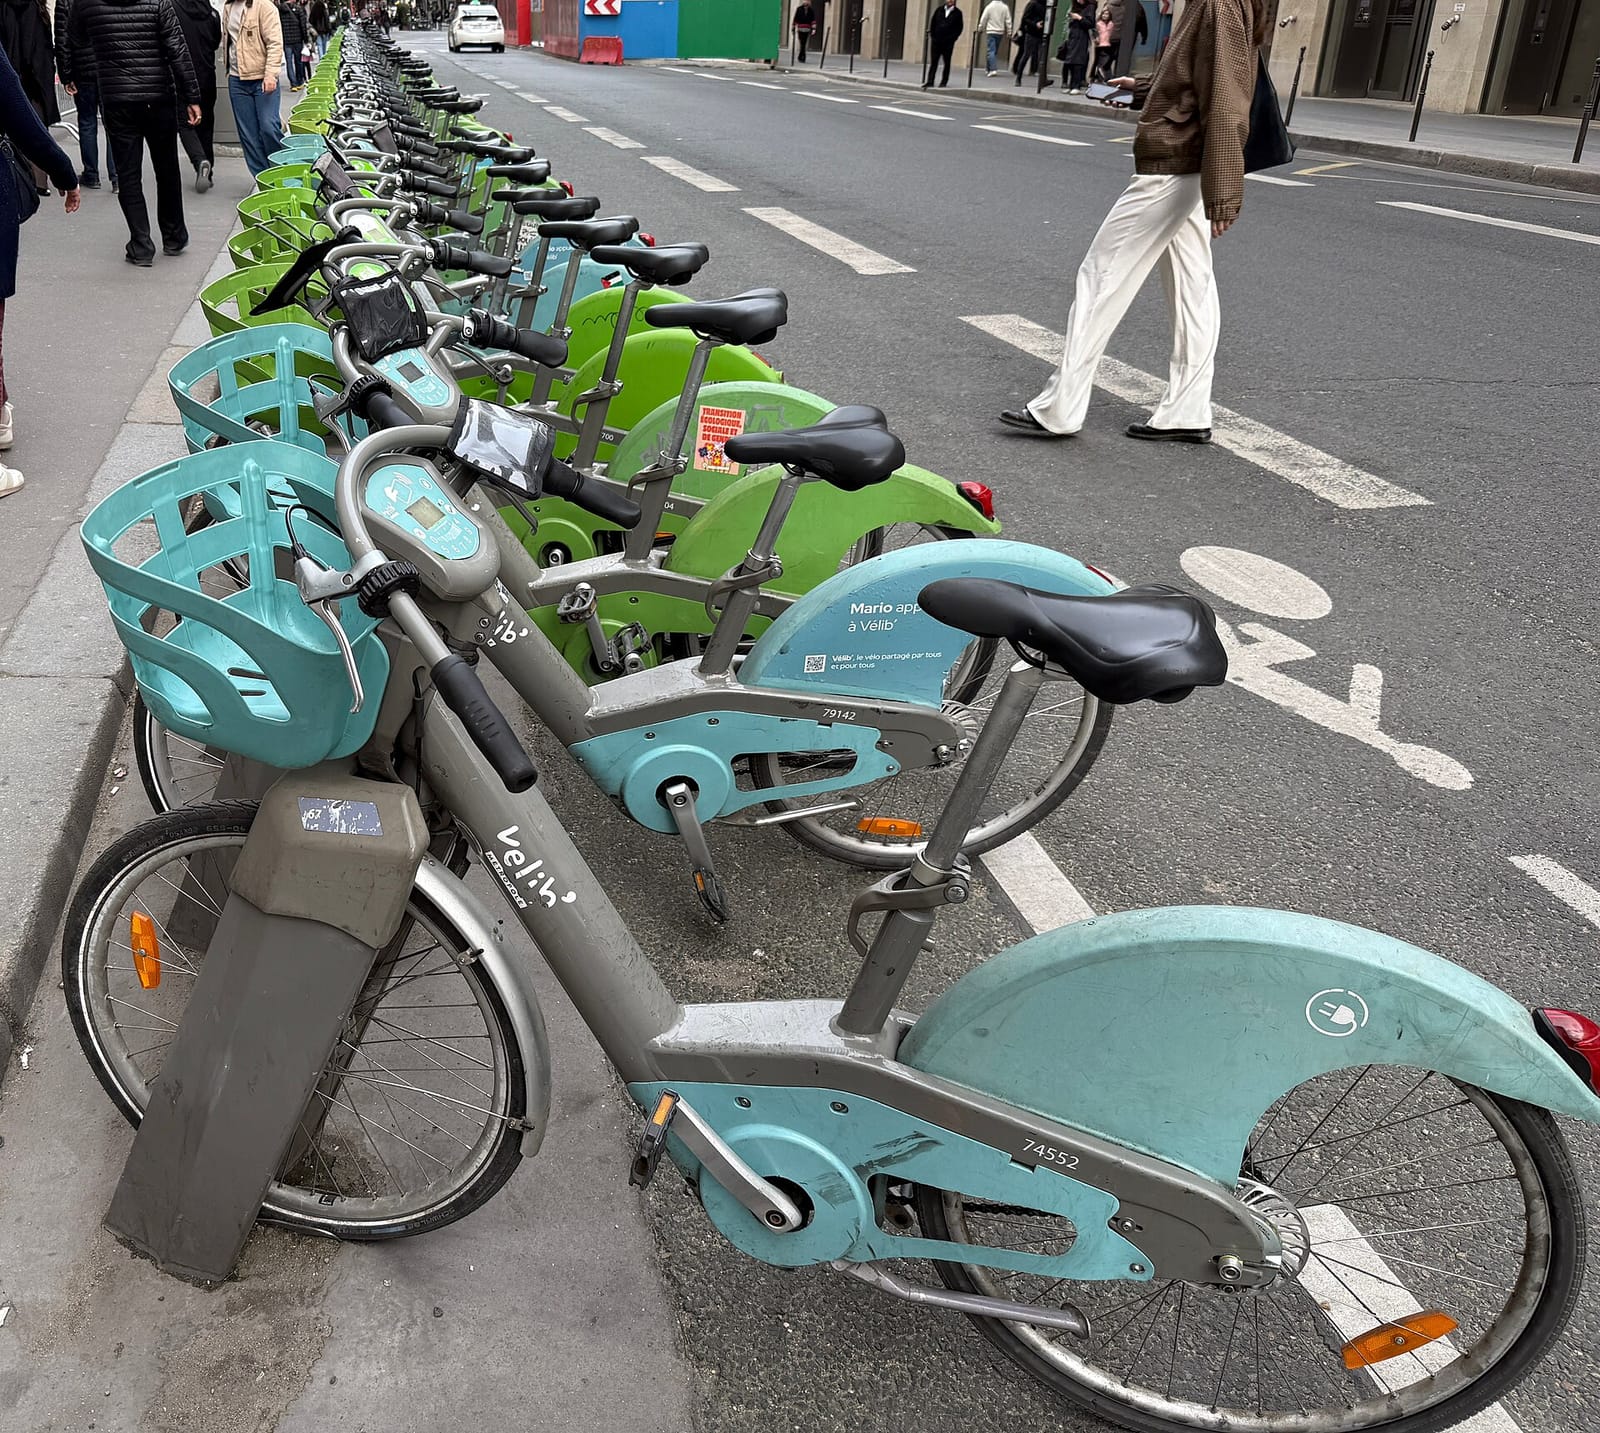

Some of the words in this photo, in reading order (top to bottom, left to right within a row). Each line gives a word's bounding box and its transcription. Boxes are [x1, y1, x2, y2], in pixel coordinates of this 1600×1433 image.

[702, 407, 742, 419] TRANSITION
[700, 415, 742, 428] ÉCOLOGIQUE,
[703, 425, 729, 435] SOCIALE
[730, 428, 738, 436] ET
[702, 433, 711, 441] DE
[850, 601, 893, 615] Mario
[896, 603, 922, 615] app
[848, 620, 856, 632] à
[864, 653, 881, 661] vélo
[881, 651, 911, 661] partagé
[911, 651, 925, 660] par
[822, 708, 857, 721] 79142
[1022, 1138, 1080, 1171] 74552
